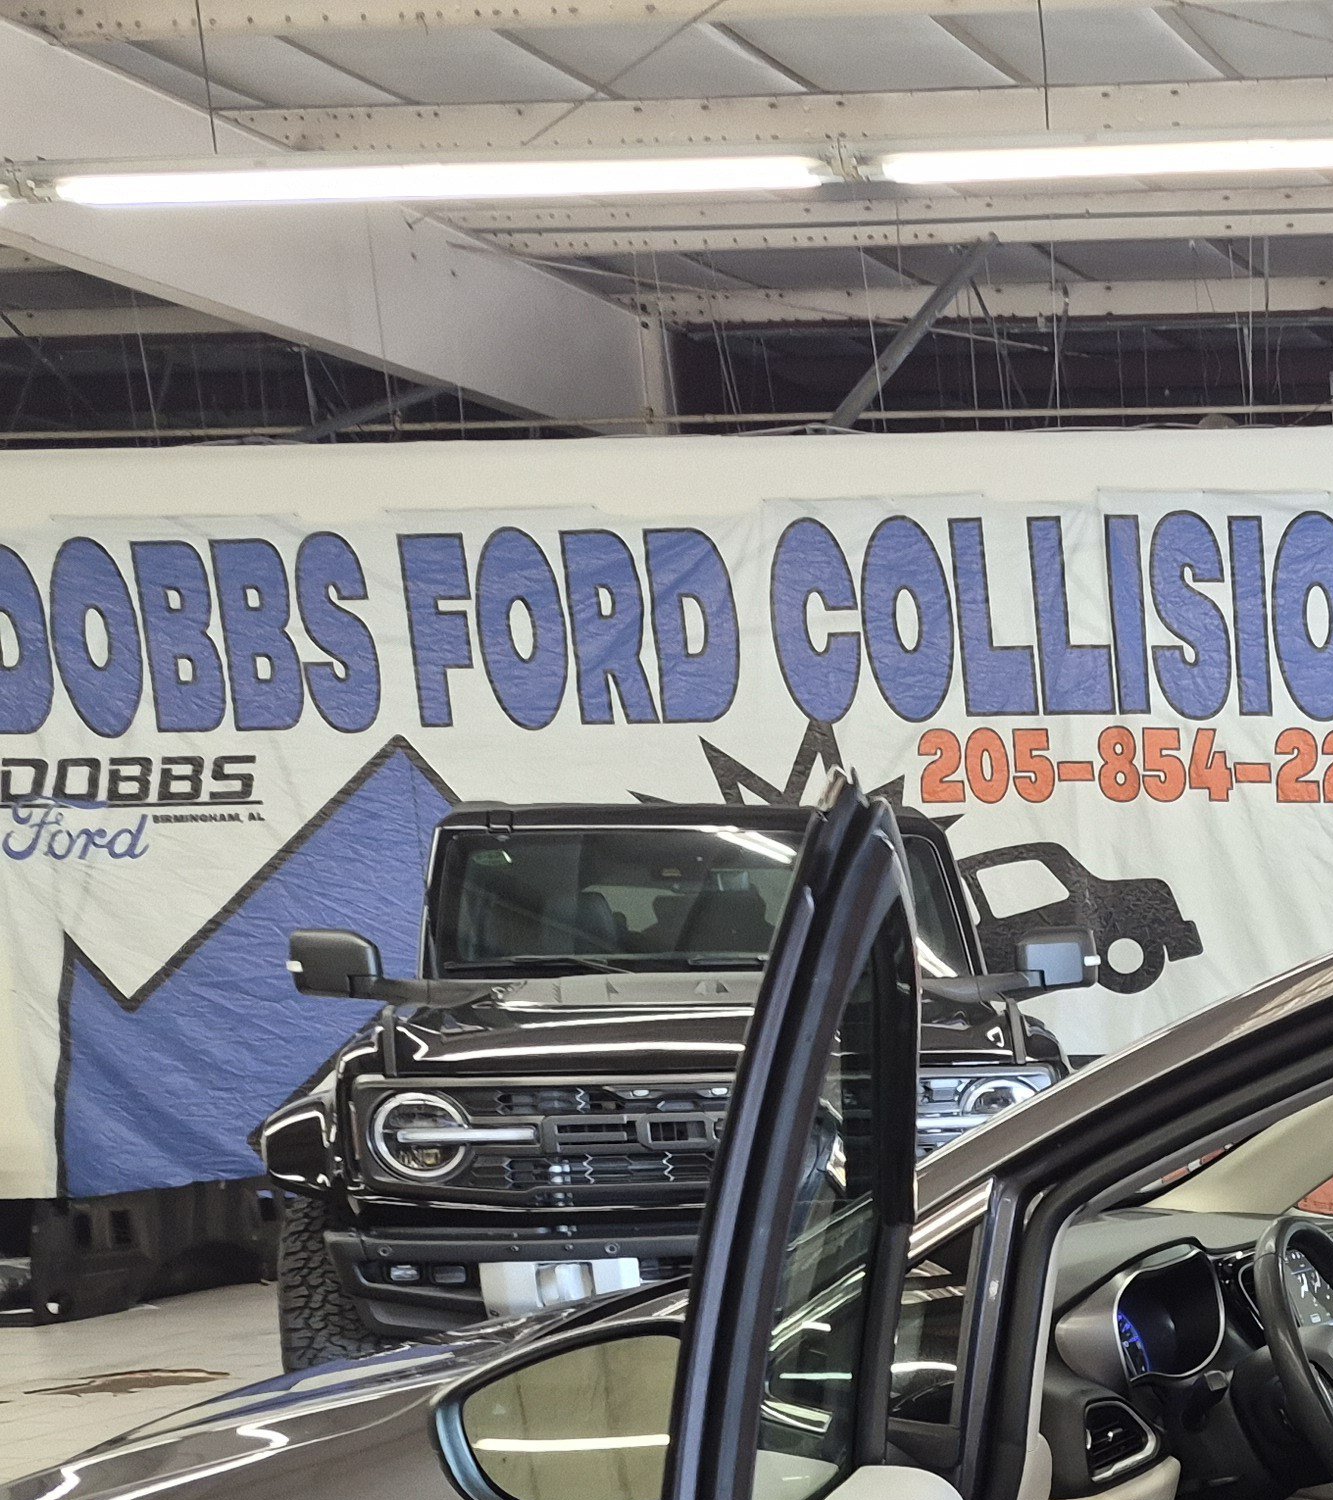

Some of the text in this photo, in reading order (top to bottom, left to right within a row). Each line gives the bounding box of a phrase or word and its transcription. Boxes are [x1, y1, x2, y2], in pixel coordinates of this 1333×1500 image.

[397, 526, 740, 731] FORD
[0, 754, 257, 801] DOBBS
[2, 796, 149, 861] Ford
